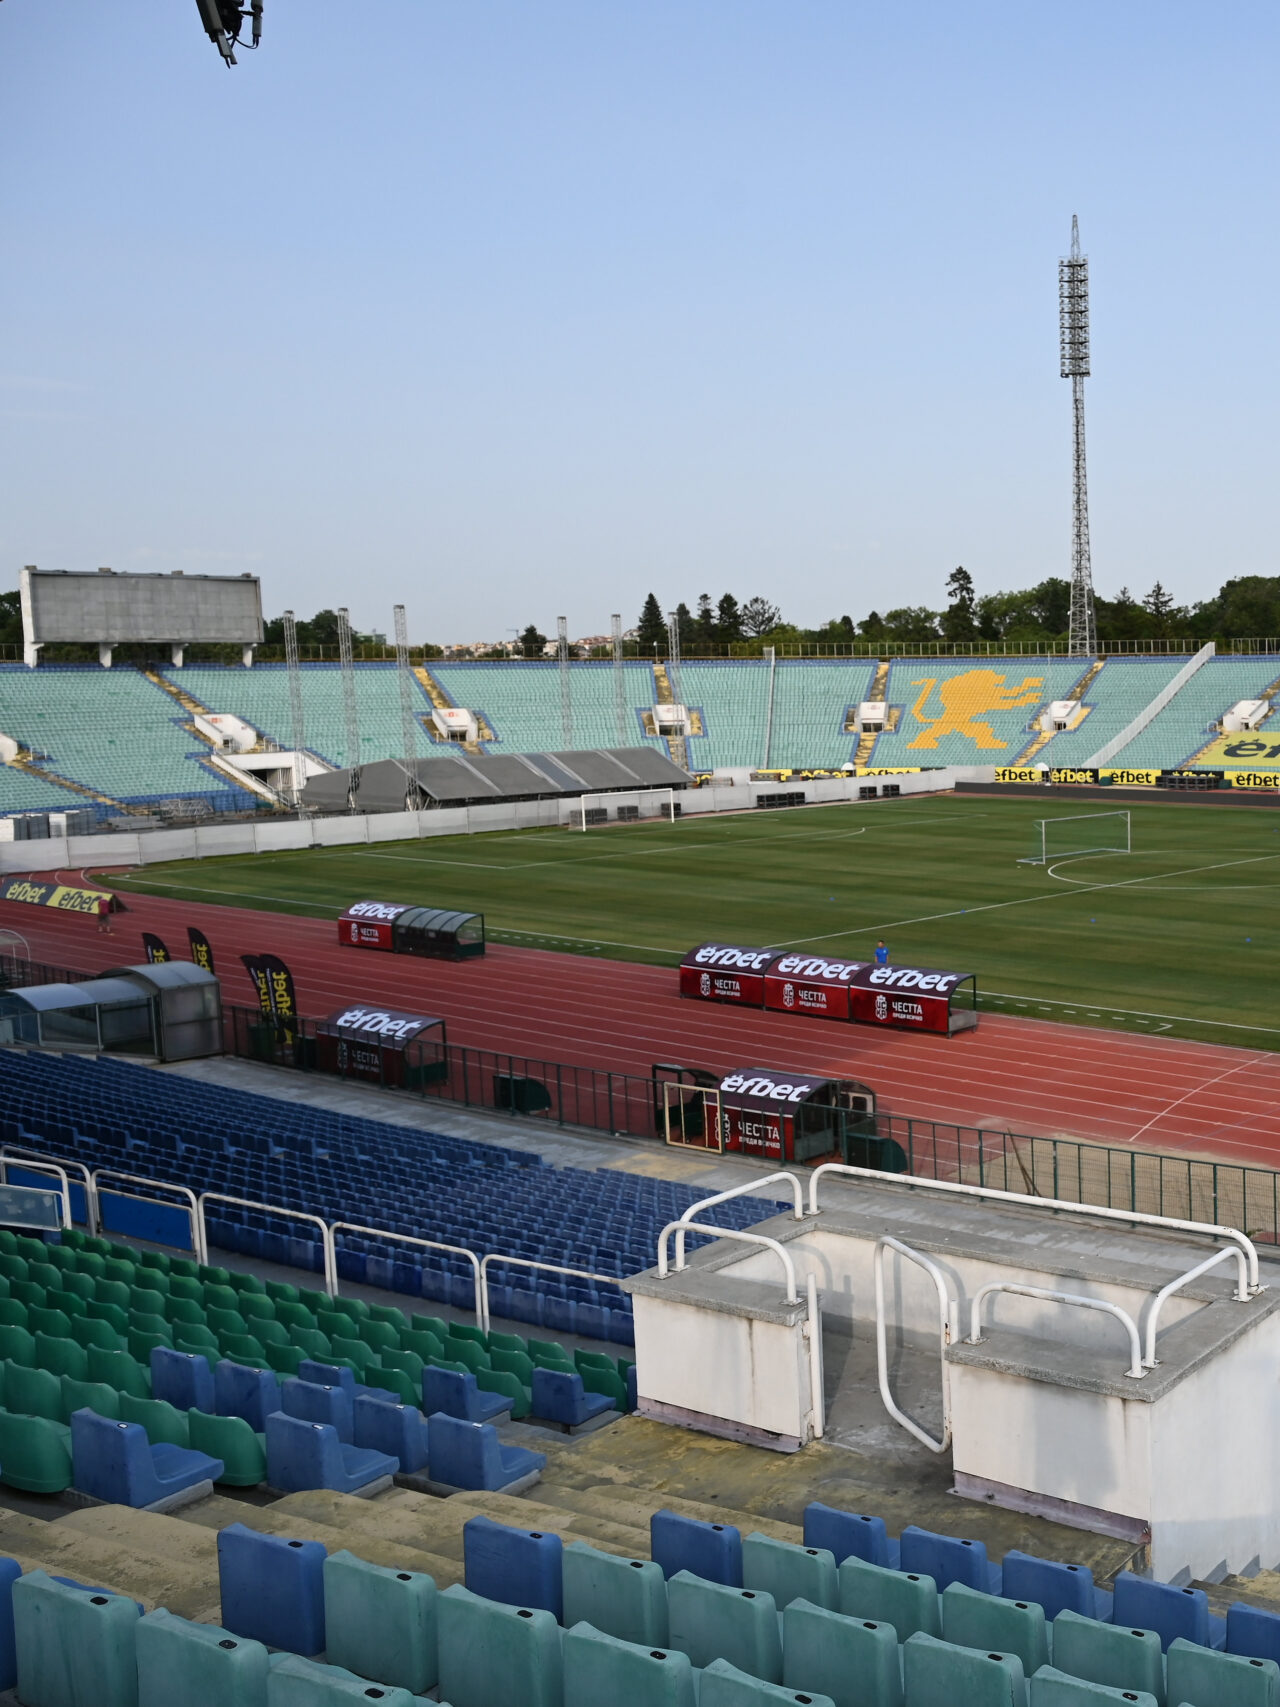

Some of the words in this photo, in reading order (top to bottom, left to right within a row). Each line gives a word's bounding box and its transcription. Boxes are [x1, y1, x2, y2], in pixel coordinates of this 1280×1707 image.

[1052, 769, 1094, 783] efbet
[1111, 771, 1152, 784] efbet
[1236, 773, 1280, 787] efbet
[6, 882, 46, 903] efbet
[58, 890, 101, 912] efbet
[349, 902, 405, 919] efbet
[695, 947, 772, 969] efbet
[778, 956, 860, 980] efbet
[869, 967, 958, 991] efbet
[798, 989, 827, 1003] ЧЕСТТА
[892, 1001, 923, 1015] ЧЕСТТА
[336, 1010, 421, 1040] efbet
[720, 1076, 811, 1103] efbet
